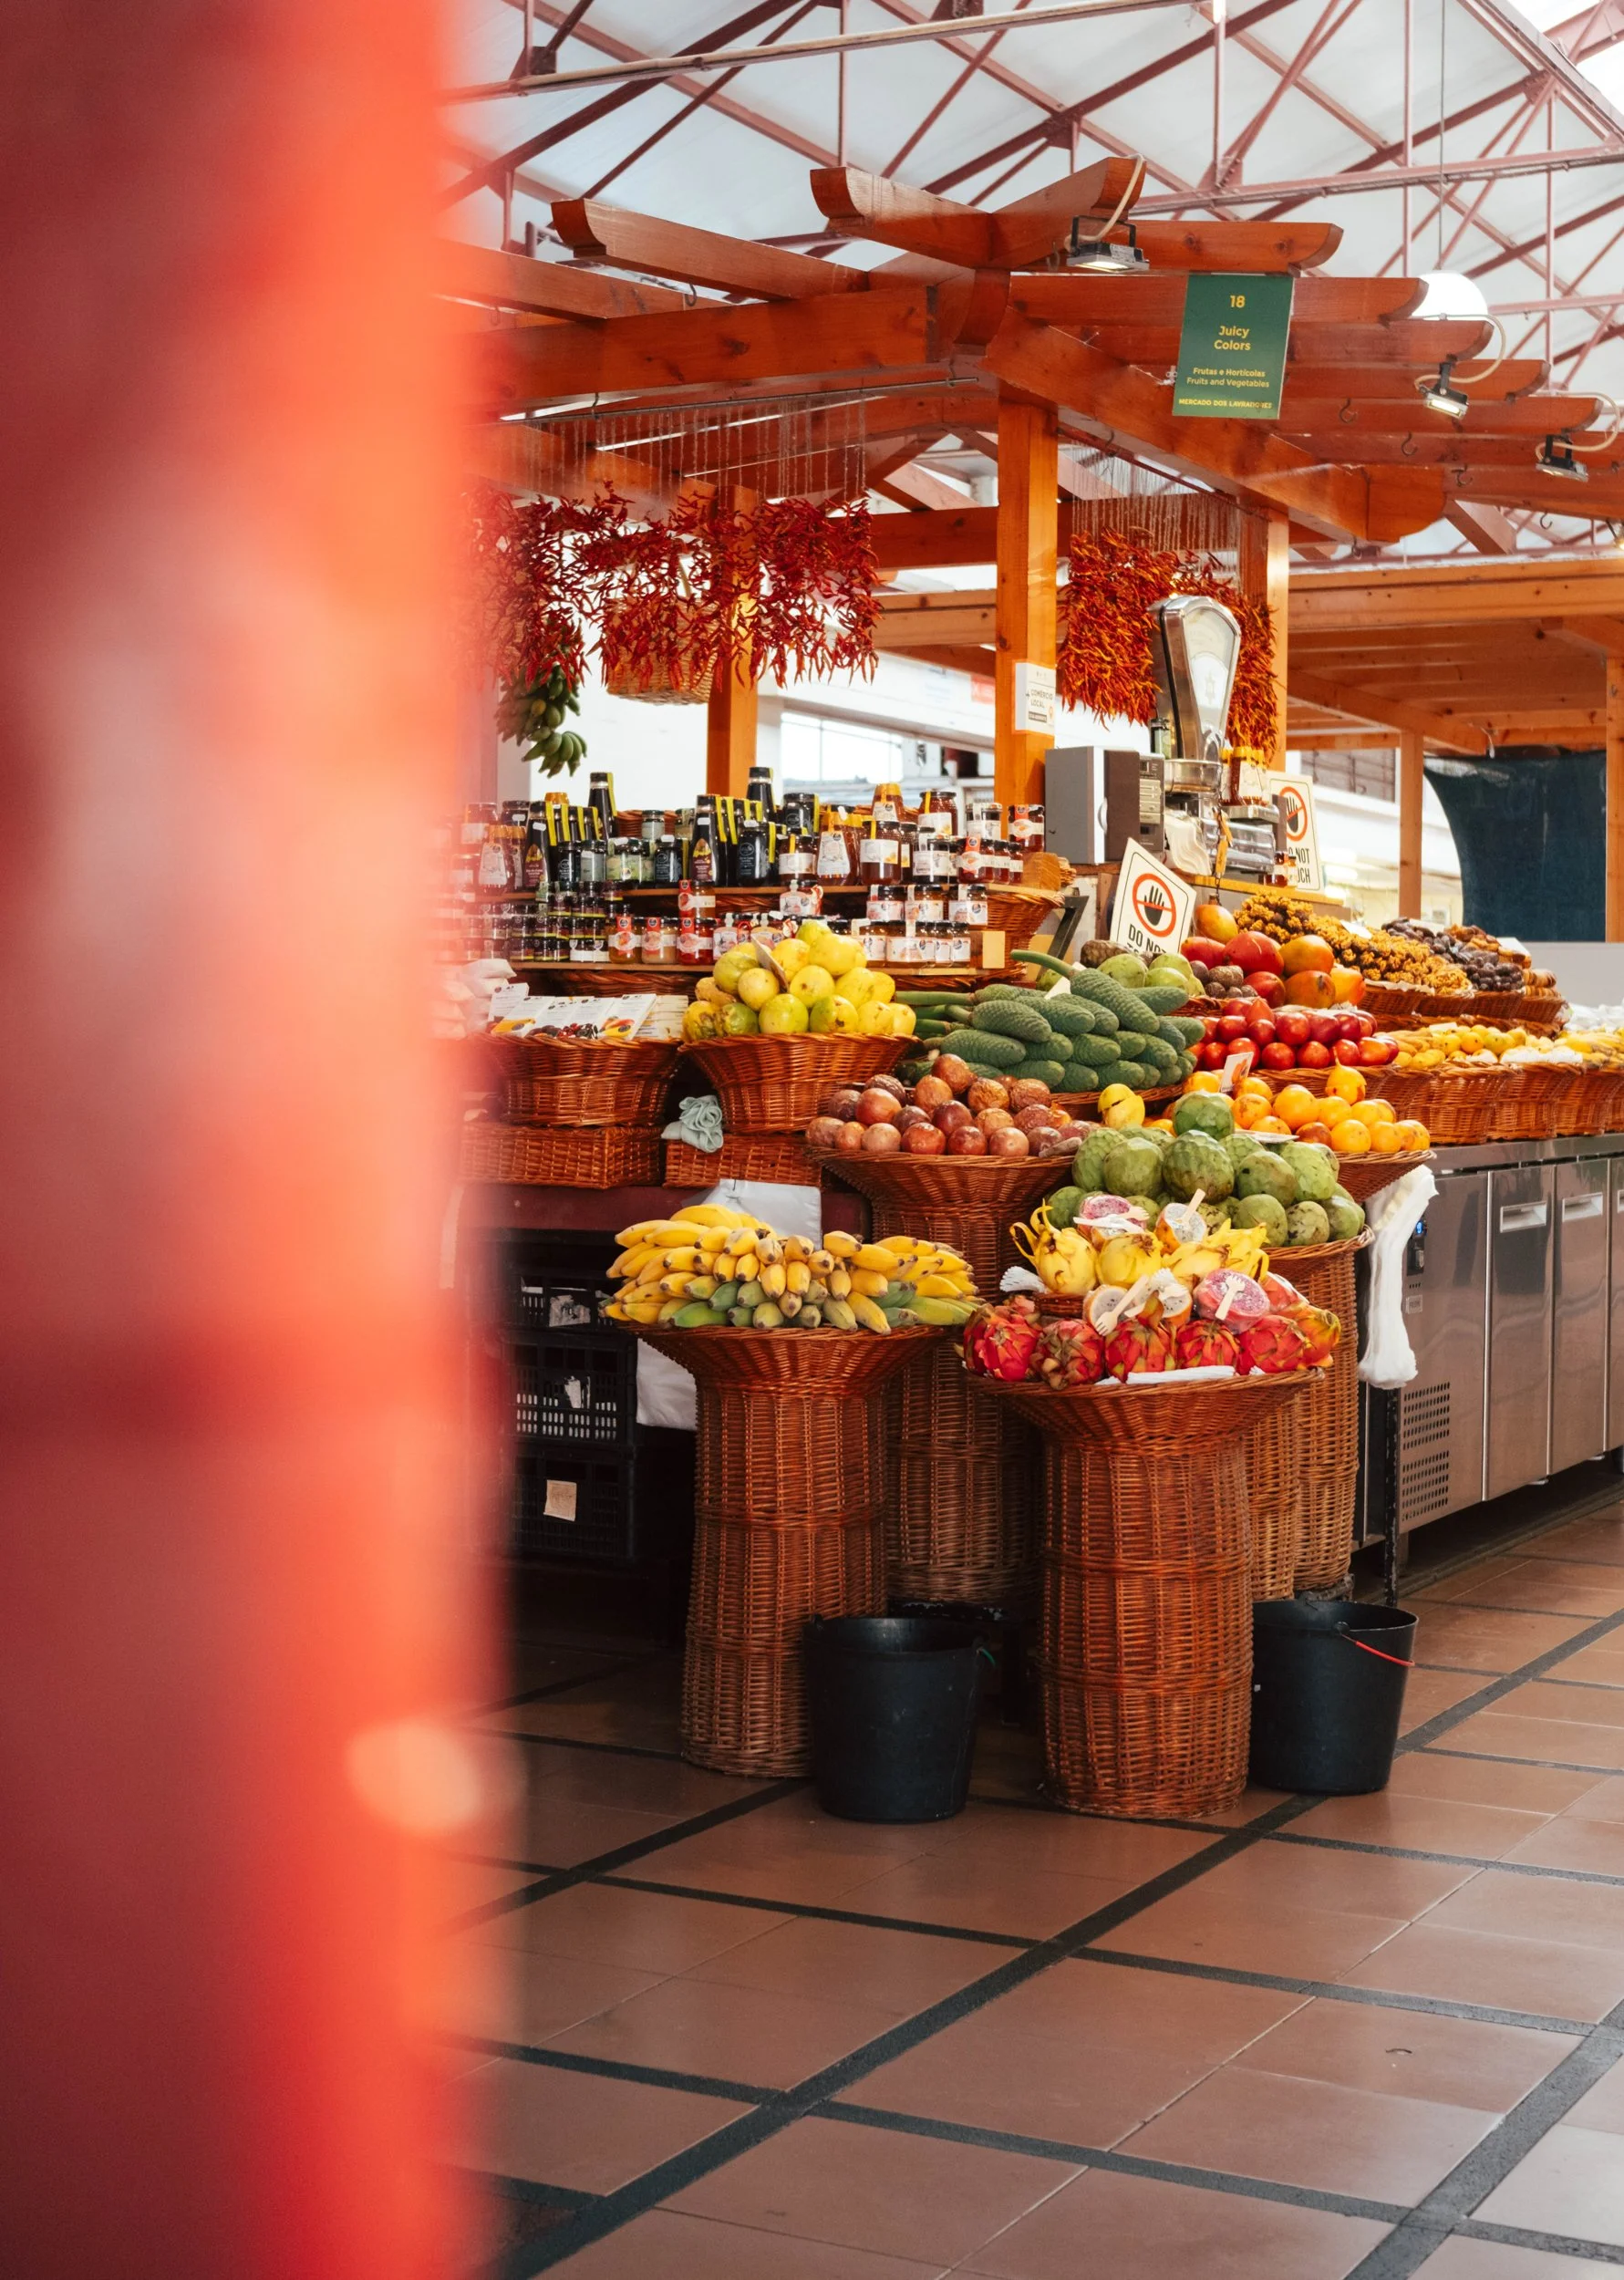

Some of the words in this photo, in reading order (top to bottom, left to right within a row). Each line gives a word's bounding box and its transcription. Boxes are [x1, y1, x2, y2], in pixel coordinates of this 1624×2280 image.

[1230, 295, 1246, 308] 18
[1218, 326, 1249, 338] Juicy
[1214, 339, 1251, 351] Colors
[1193, 368, 1217, 376] Frutas
[1186, 377, 1209, 386] Fruits
[1209, 378, 1226, 386] and
[1226, 378, 1269, 389] Vegetables
[1178, 398, 1212, 407] MERCADO
[1213, 399, 1227, 408] DOS
[1296, 847, 1310, 865] NOT
[1128, 924, 1143, 948] DO
[1146, 938, 1166, 954] NO
